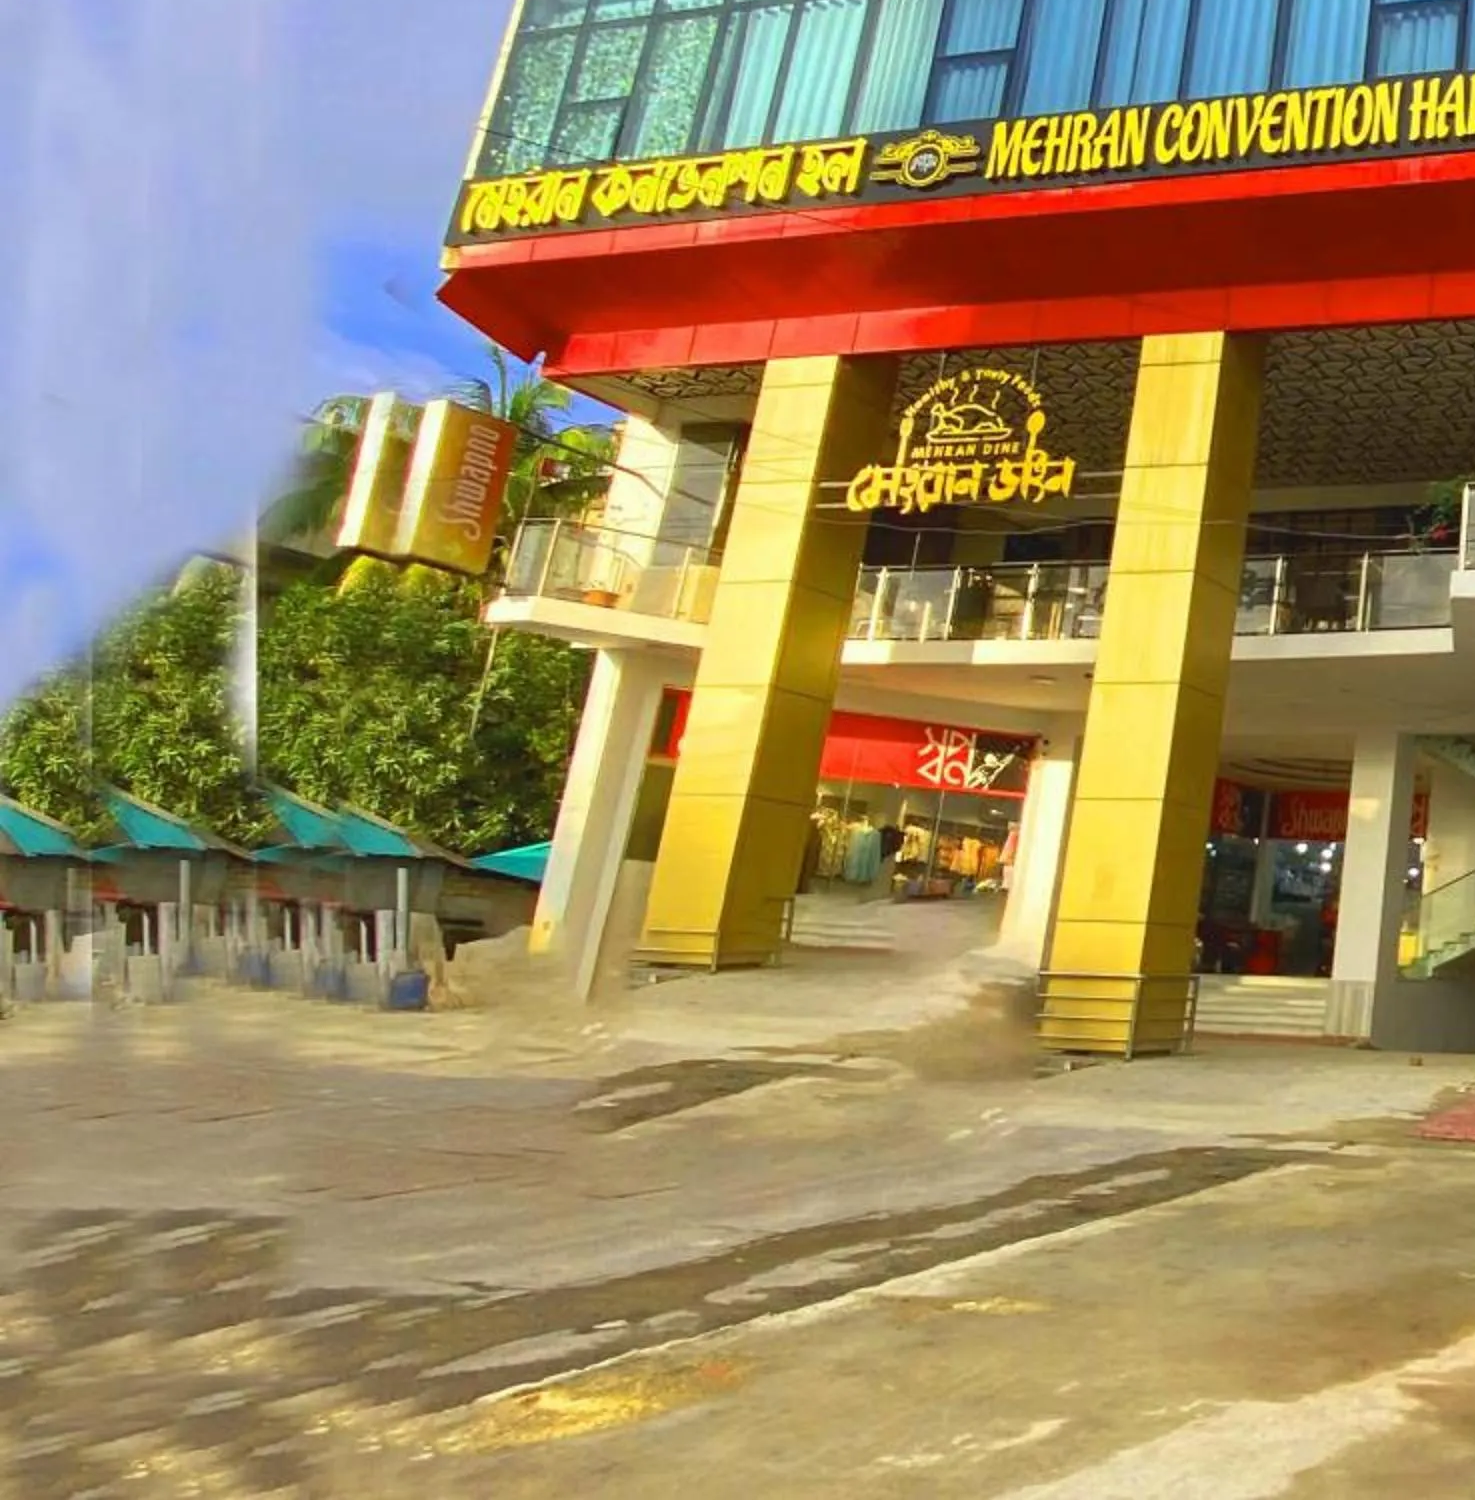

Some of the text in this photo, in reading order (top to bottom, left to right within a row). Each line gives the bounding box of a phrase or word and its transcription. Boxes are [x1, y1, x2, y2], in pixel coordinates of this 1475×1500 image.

[797, 138, 867, 195] হল
[984, 106, 1151, 180] MEHRAN
[1153, 81, 1403, 168] CONVENTION
[440, 424, 500, 540] Shwapno
